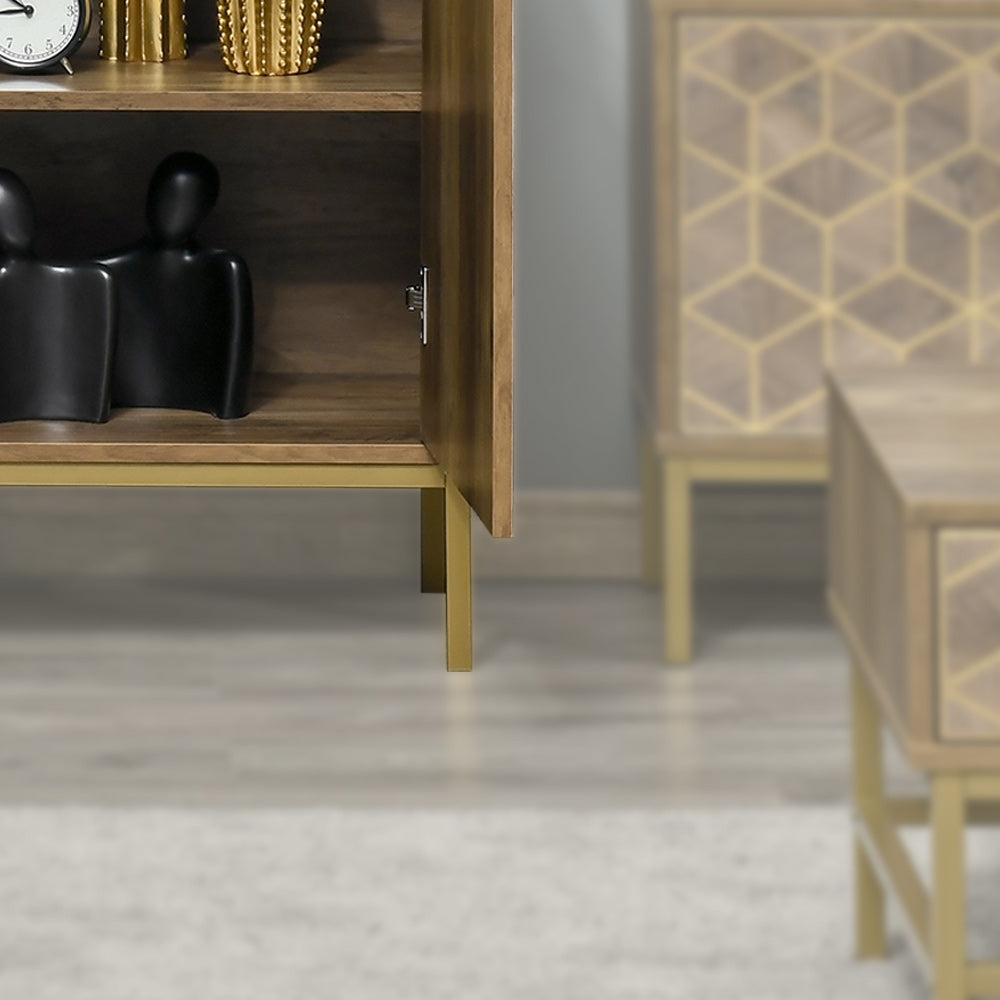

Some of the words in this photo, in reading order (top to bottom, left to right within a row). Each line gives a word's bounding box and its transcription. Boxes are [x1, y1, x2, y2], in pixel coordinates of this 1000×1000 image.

[66, 5, 75, 17] 3
[59, 24, 67, 35] 4
[6, 37, 13, 49] 7
[24, 43, 33, 55] 6
[45, 39, 53, 51] 5
